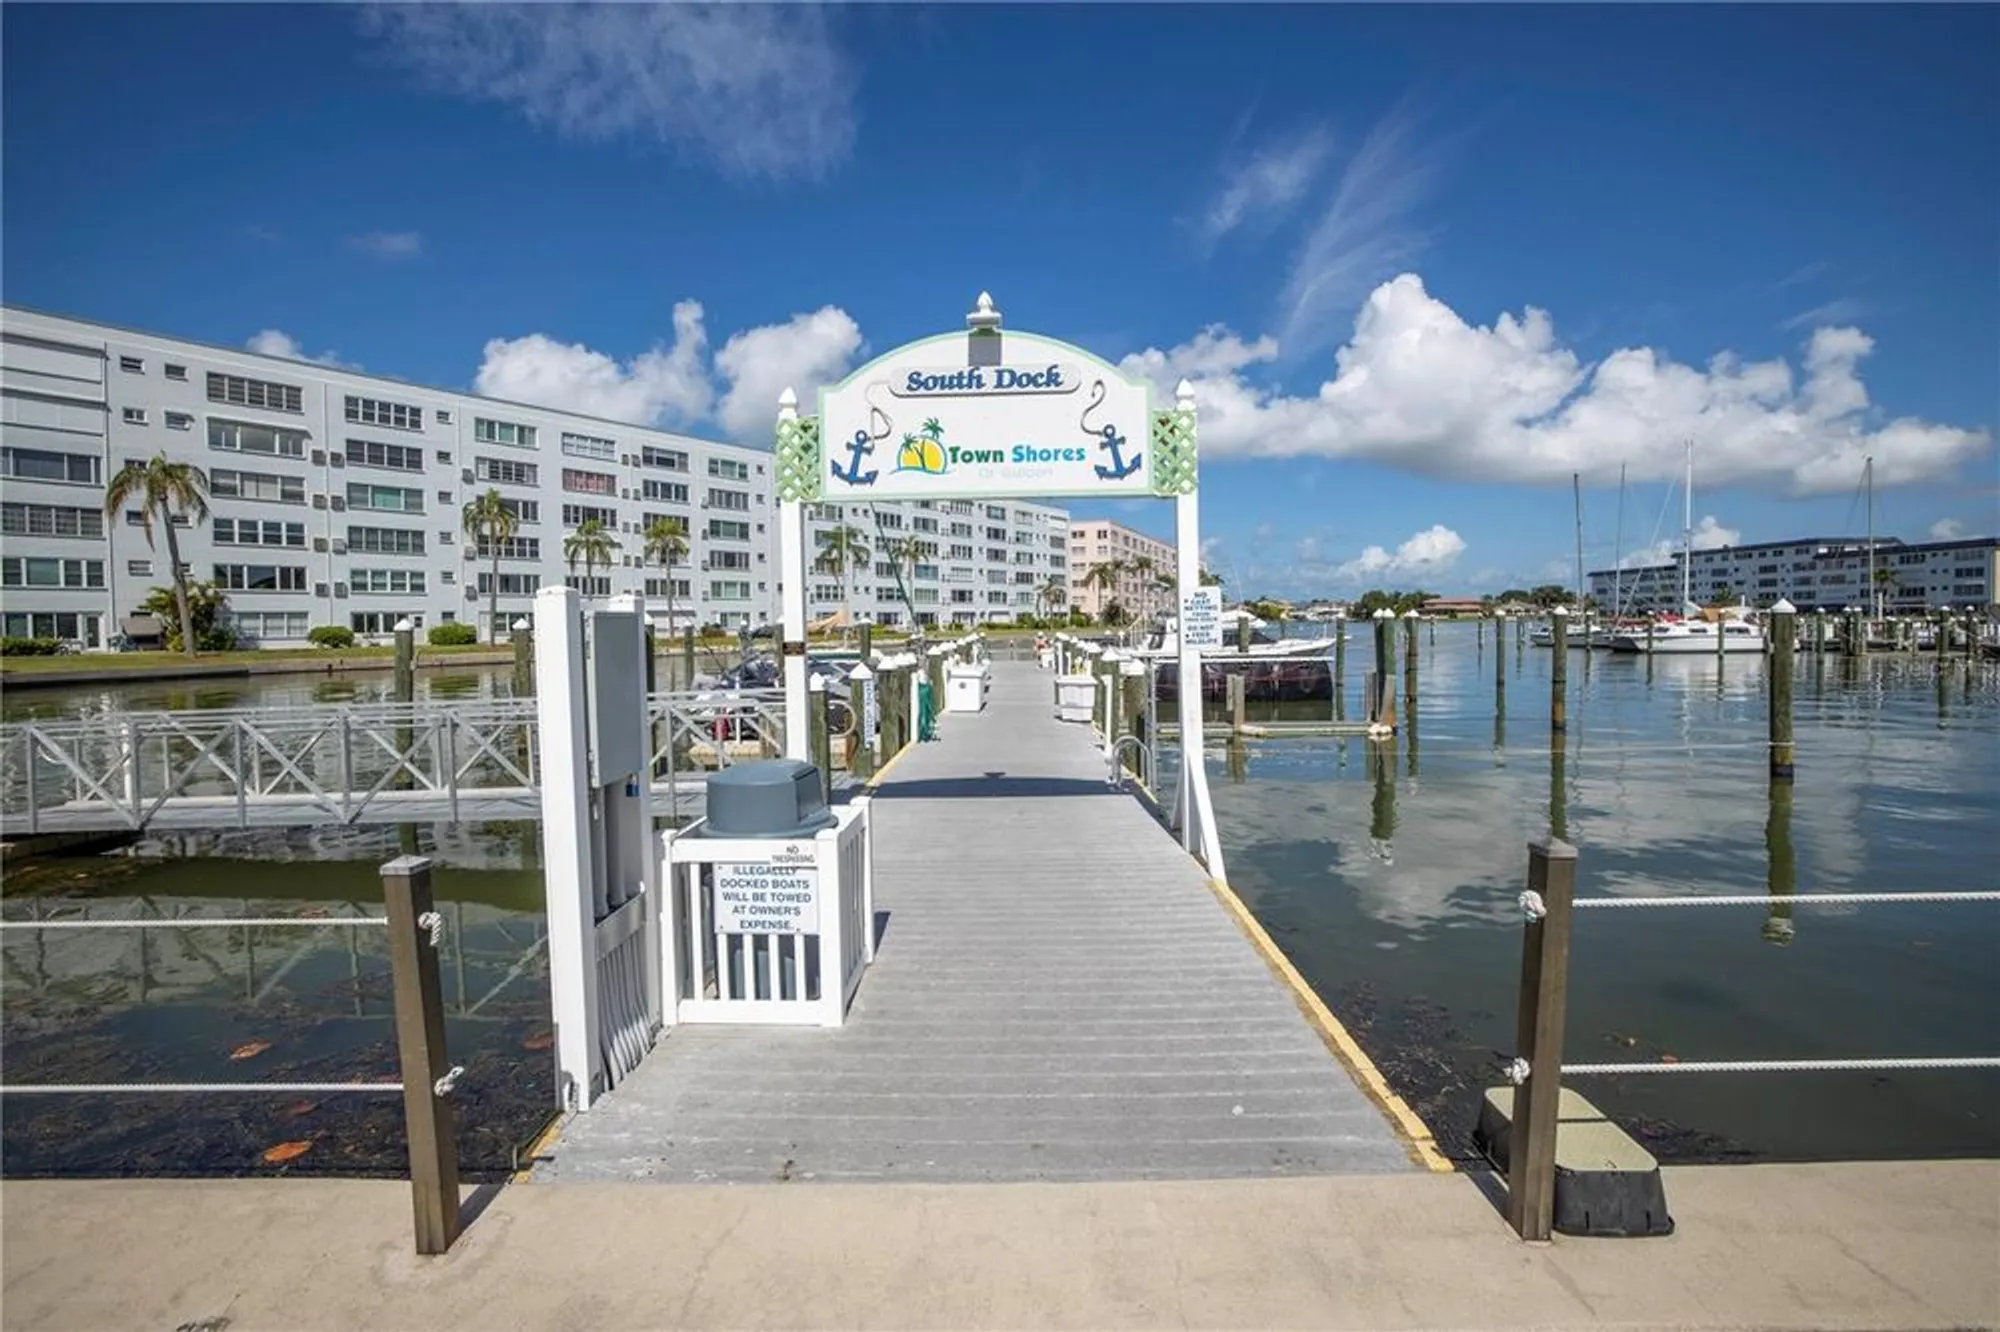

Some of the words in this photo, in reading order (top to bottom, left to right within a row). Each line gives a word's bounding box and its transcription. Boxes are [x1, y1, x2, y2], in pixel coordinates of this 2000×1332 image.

[906, 366, 986, 391] South
[994, 364, 1064, 389] Dock
[948, 446, 1004, 464] Town
[1011, 445, 1086, 462] Shores
[786, 845, 799, 854] NO
[720, 878, 769, 889] DOCKED
[771, 878, 810, 889] BOATS
[722, 892, 750, 902] WILL
[752, 892, 767, 902] BE
[770, 892, 811, 903] TOWED
[732, 905, 746, 915] AT
